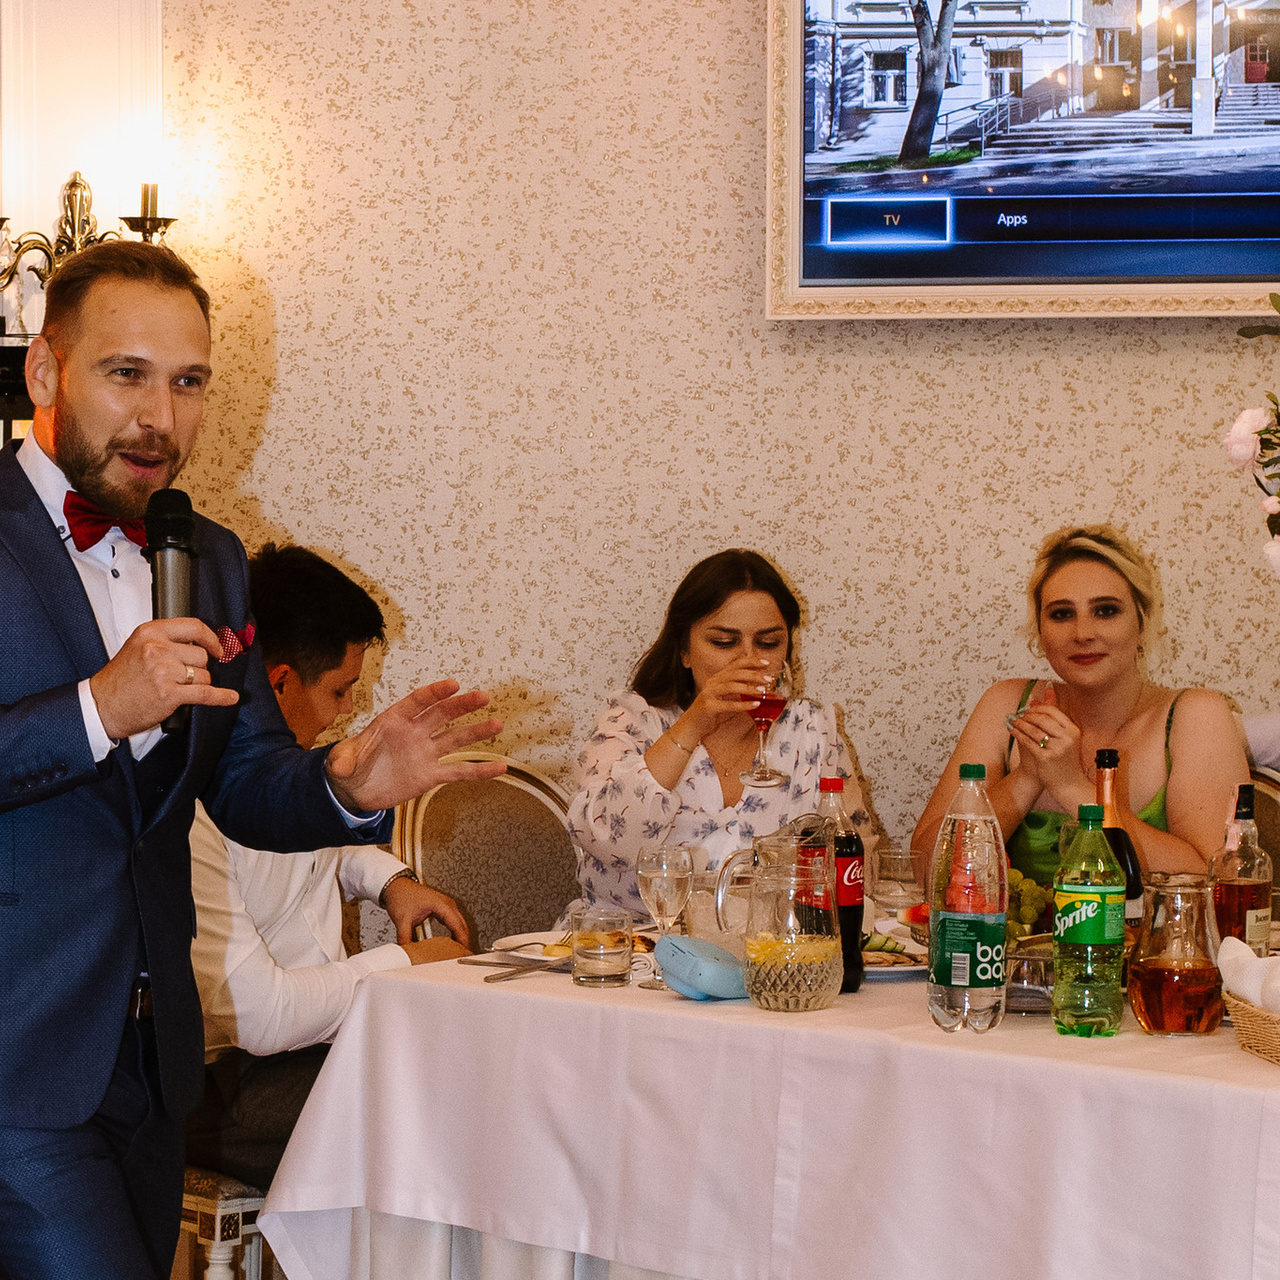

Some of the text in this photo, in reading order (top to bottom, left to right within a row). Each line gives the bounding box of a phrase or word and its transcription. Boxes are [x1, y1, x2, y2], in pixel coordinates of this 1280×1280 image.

[883, 214, 901, 226] TV
[997, 213, 1028, 227] Apps
[1054, 901, 1101, 937] Sprite
[976, 941, 1004, 963] bo
[975, 961, 1004, 982] aq
